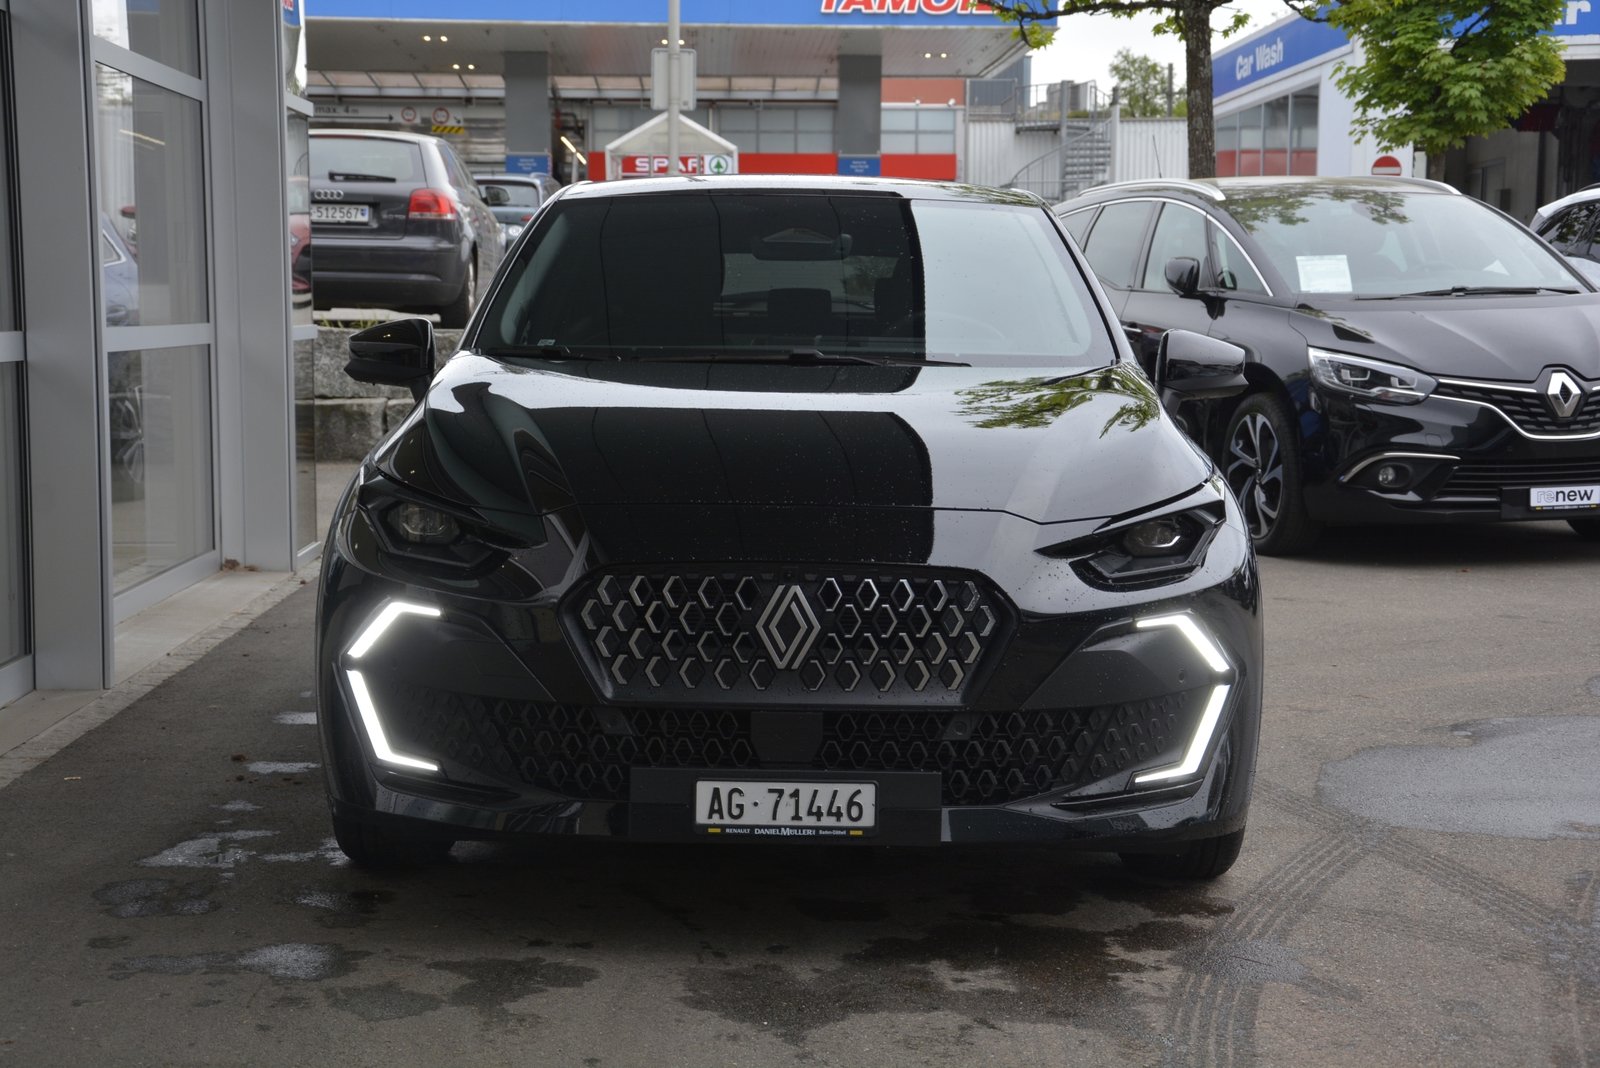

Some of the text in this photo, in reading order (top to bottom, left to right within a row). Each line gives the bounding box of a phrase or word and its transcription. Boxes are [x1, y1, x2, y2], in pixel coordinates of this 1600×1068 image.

[1236, 37, 1283, 80] Car Wash
[316, 207, 359, 219] 512567
[1536, 489, 1594, 503] renew
[767, 788, 864, 823] 71446
